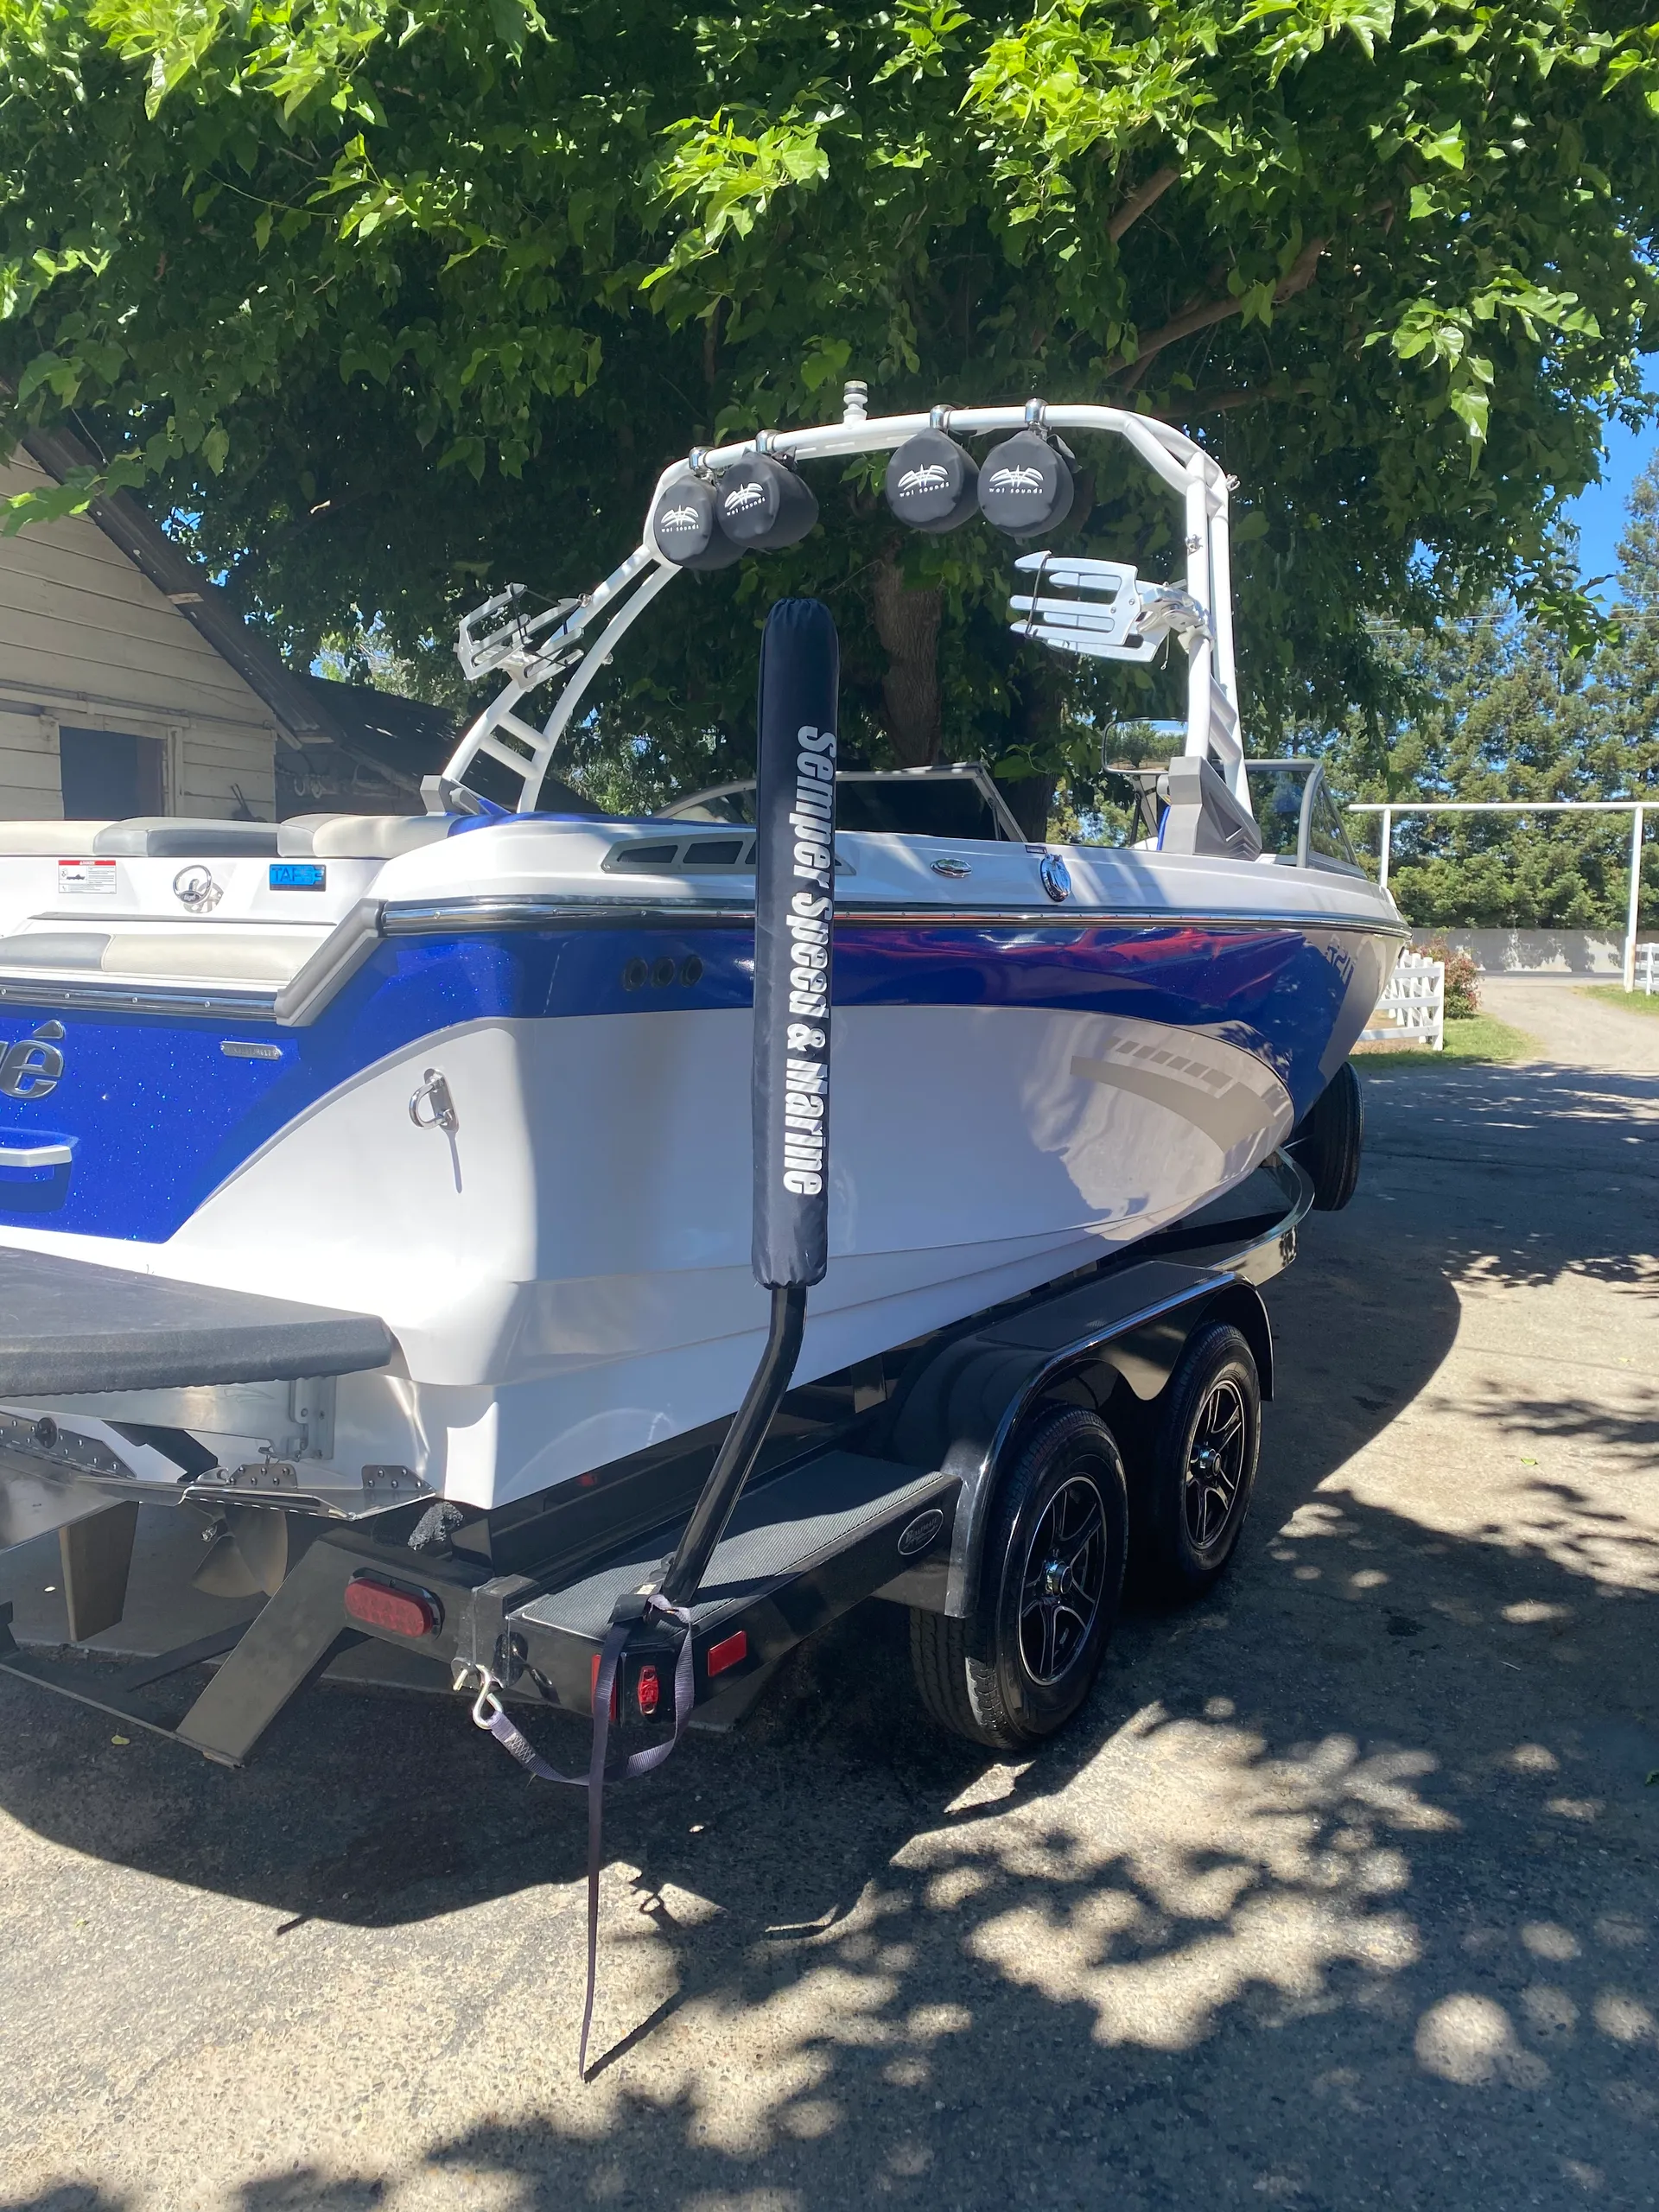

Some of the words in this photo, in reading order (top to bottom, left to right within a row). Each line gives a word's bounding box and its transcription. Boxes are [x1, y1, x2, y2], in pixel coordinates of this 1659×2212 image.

[918, 481, 950, 493] sounds
[741, 497, 766, 512] sounds
[676, 524, 699, 532] sounds
[793, 724, 836, 891] Semper
[786, 891, 834, 1020] Speed
[787, 1022, 826, 1052] &
[783, 1058, 828, 1196] Marine
